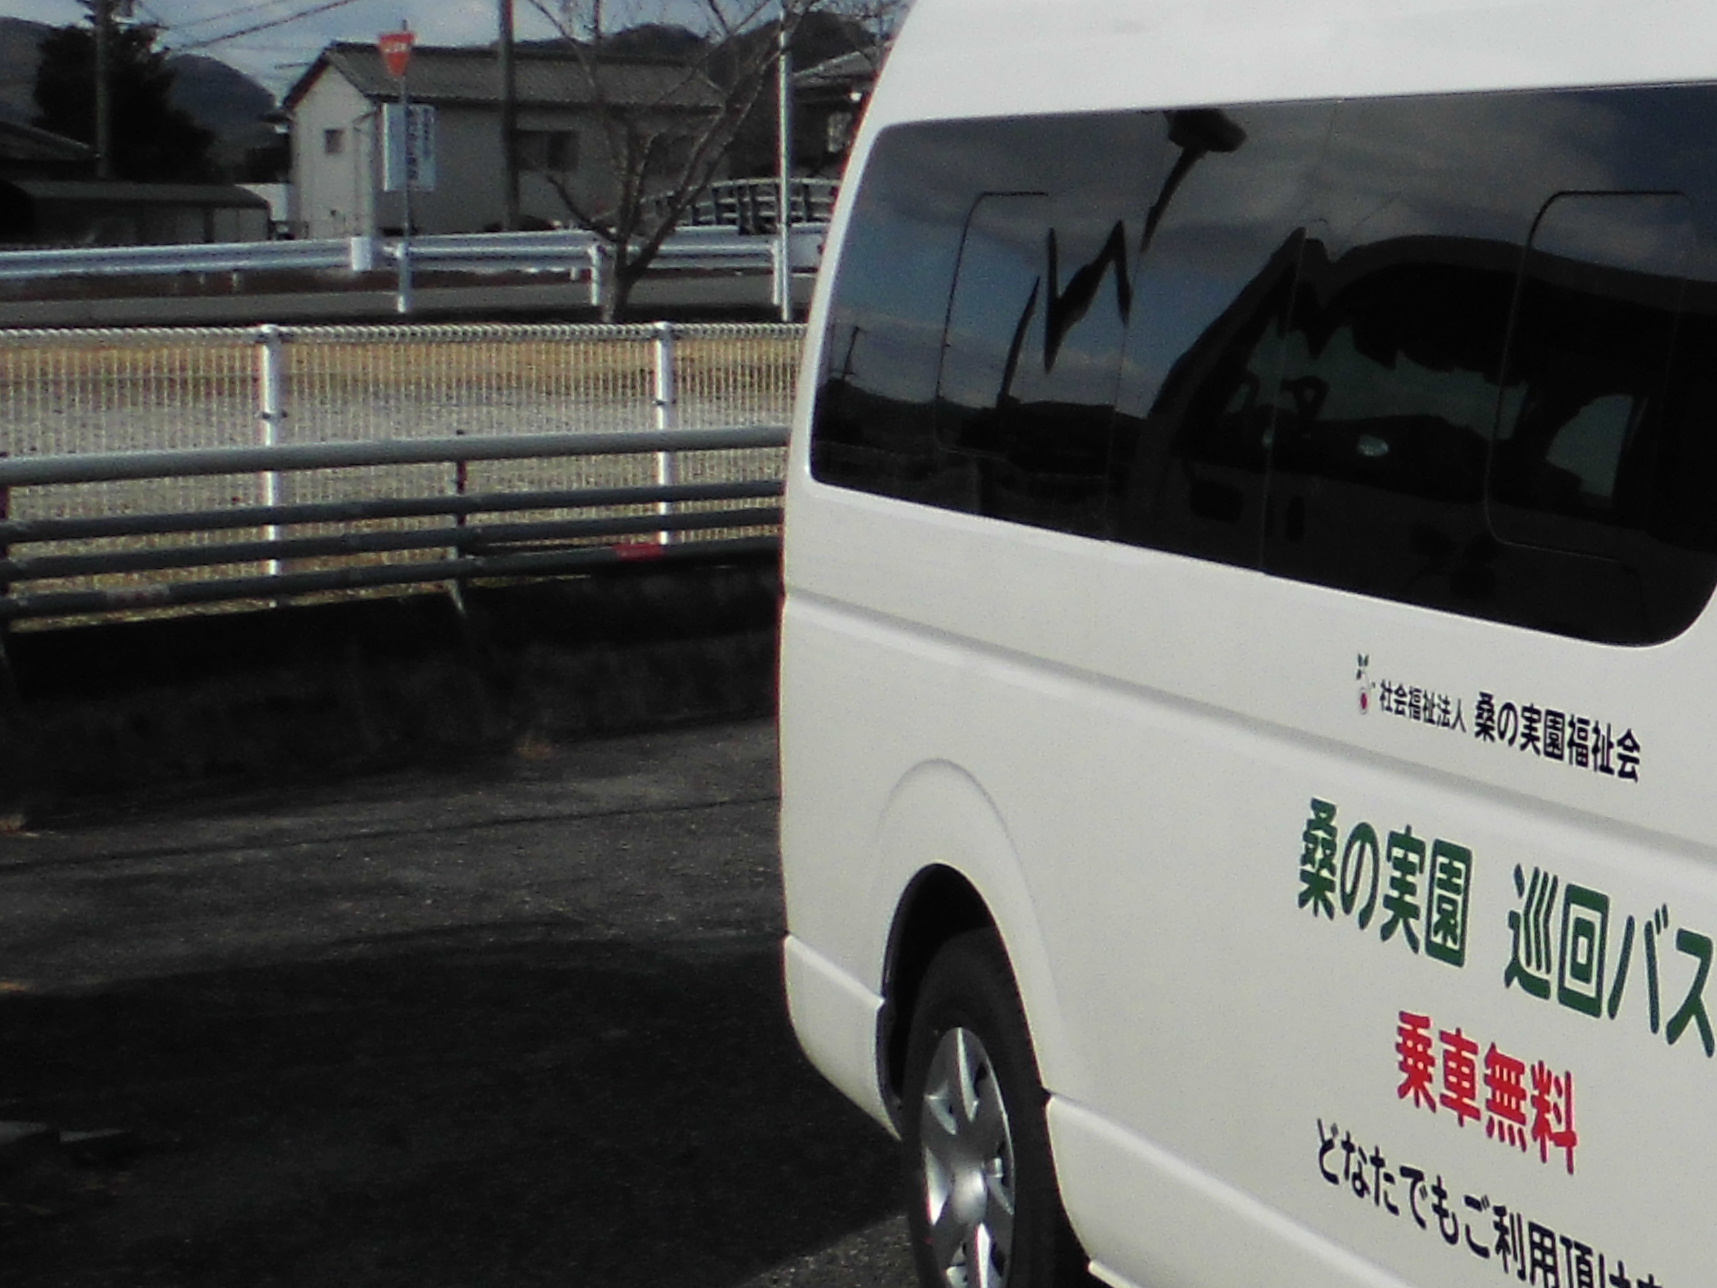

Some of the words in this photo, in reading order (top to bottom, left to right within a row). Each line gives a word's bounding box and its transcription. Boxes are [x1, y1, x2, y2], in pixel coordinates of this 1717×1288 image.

[1379, 679, 1466, 733] 社会福祉法人
[1474, 691, 1641, 782] 桑の実園福祉会
[1298, 797, 1473, 969] 桑の実園
[1503, 862, 1716, 1058] 巡回バス
[1394, 1010, 1578, 1175] 乗車無料
